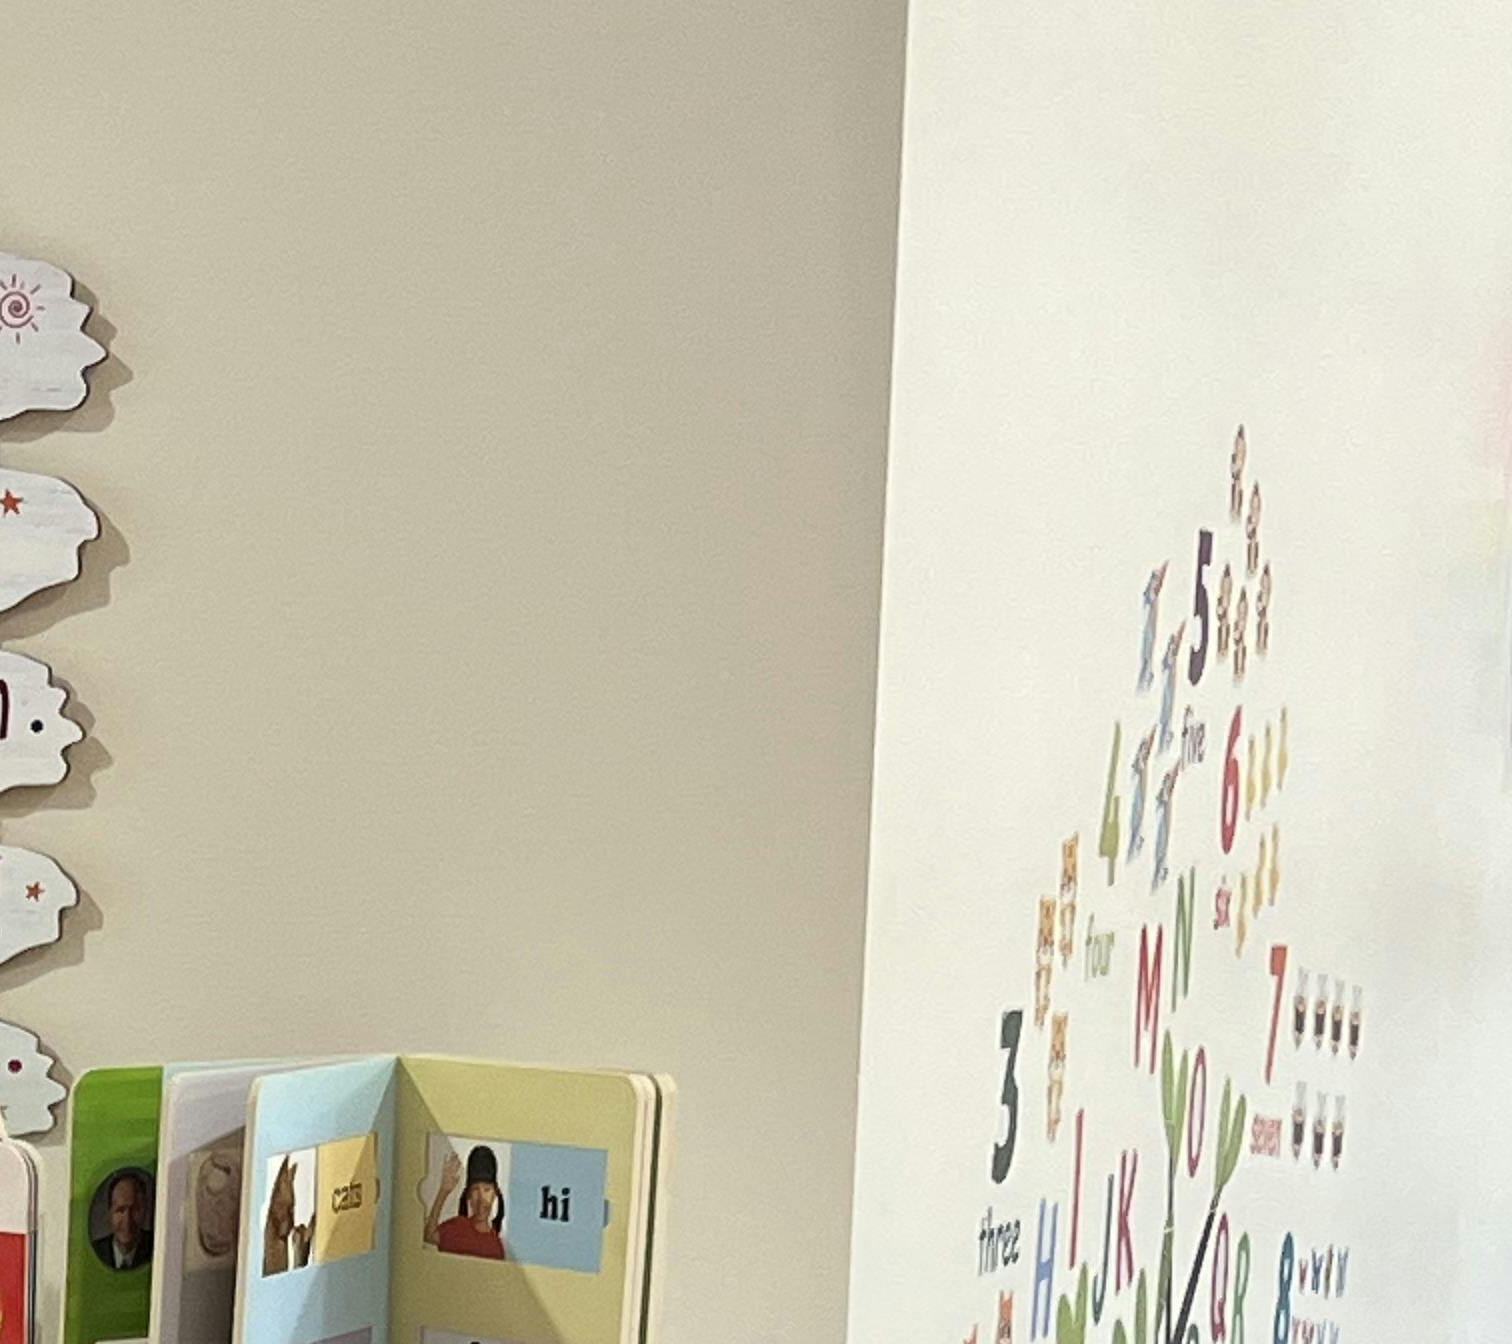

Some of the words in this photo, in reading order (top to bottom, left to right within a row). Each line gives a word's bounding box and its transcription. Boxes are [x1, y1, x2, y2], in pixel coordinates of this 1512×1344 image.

[1189, 528, 1213, 686] 5
[1222, 705, 1242, 855] 6
[1135, 923, 1162, 1075] M
[1172, 866, 1195, 1012] N
[1269, 944, 1288, 1084] 7
[991, 1009, 1023, 1184] 3
[539, 1184, 571, 1222] hi
[979, 1207, 1021, 1276] three
[1031, 1198, 1058, 1342] H
[1093, 1174, 1114, 1326] J
[1116, 1149, 1138, 1295] K
[1210, 1213, 1229, 1344] Q
